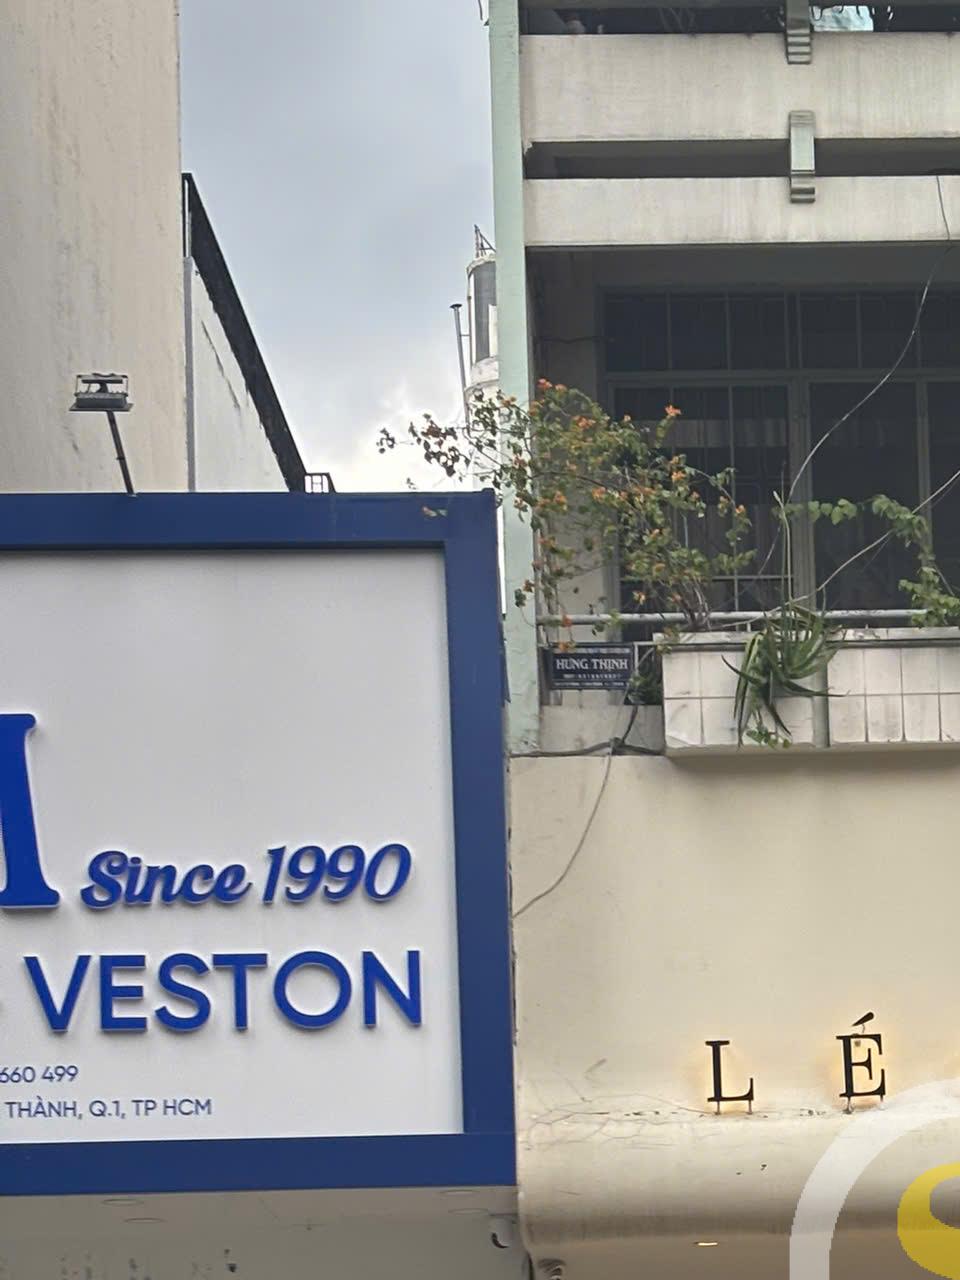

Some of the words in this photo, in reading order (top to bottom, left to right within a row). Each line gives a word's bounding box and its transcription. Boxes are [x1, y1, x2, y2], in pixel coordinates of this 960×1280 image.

[79, 850, 252, 910] Since
[262, 843, 412, 904] 1990
[23, 950, 424, 1033] VESTON
[41, 1064, 78, 1082] 499
[4, 1095, 83, 1120] THÀNH,
[88, 1099, 126, 1118] Q.1,
[131, 1099, 157, 1116] TP
[163, 1098, 212, 1115] HCM
